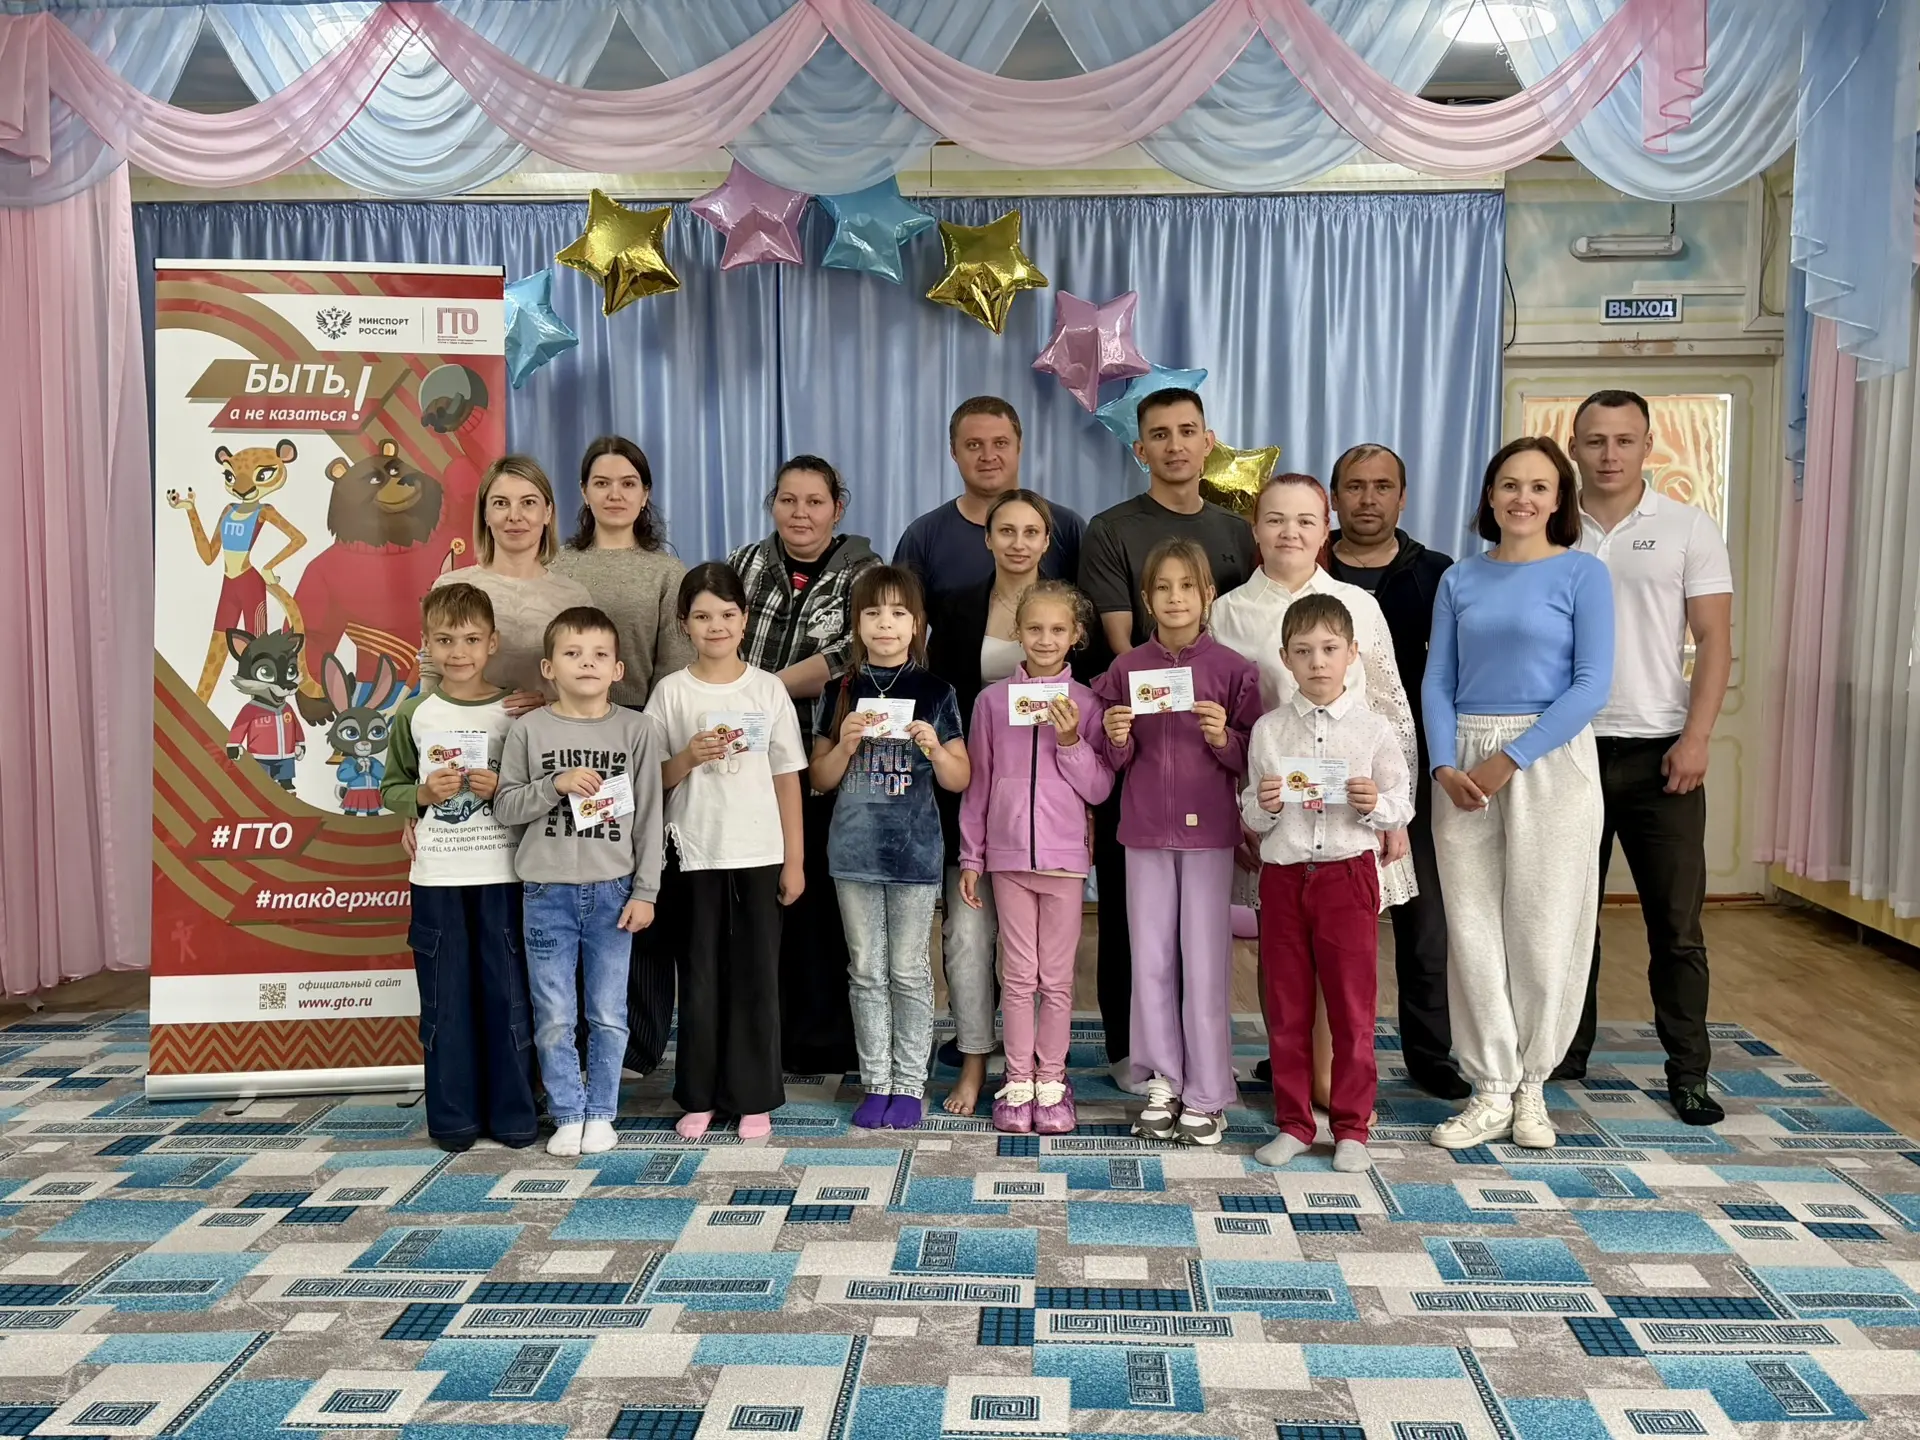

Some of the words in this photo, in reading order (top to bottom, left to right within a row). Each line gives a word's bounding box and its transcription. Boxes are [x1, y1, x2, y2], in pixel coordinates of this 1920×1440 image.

[1608, 301, 1674, 317] ВЫХОД
[358, 317, 409, 326] МИНСПОРТ
[437, 307, 479, 335] ГТО
[358, 328, 397, 336] РОССИИ
[245, 363, 351, 399] БЫТЬ,
[229, 408, 241, 420] а
[244, 408, 265, 420] не
[268, 409, 347, 422] казаться
[1632, 539, 1656, 549] EA7
[560, 749, 609, 769] LISTEN
[869, 772, 913, 796] POP
[211, 822, 294, 850] #ГТО
[460, 826, 484, 834] SPORTY
[477, 833, 507, 841] FINISHING
[298, 977, 372, 992] официальный
[374, 977, 402, 988] сайт
[298, 997, 373, 1011] www.gto.ru
